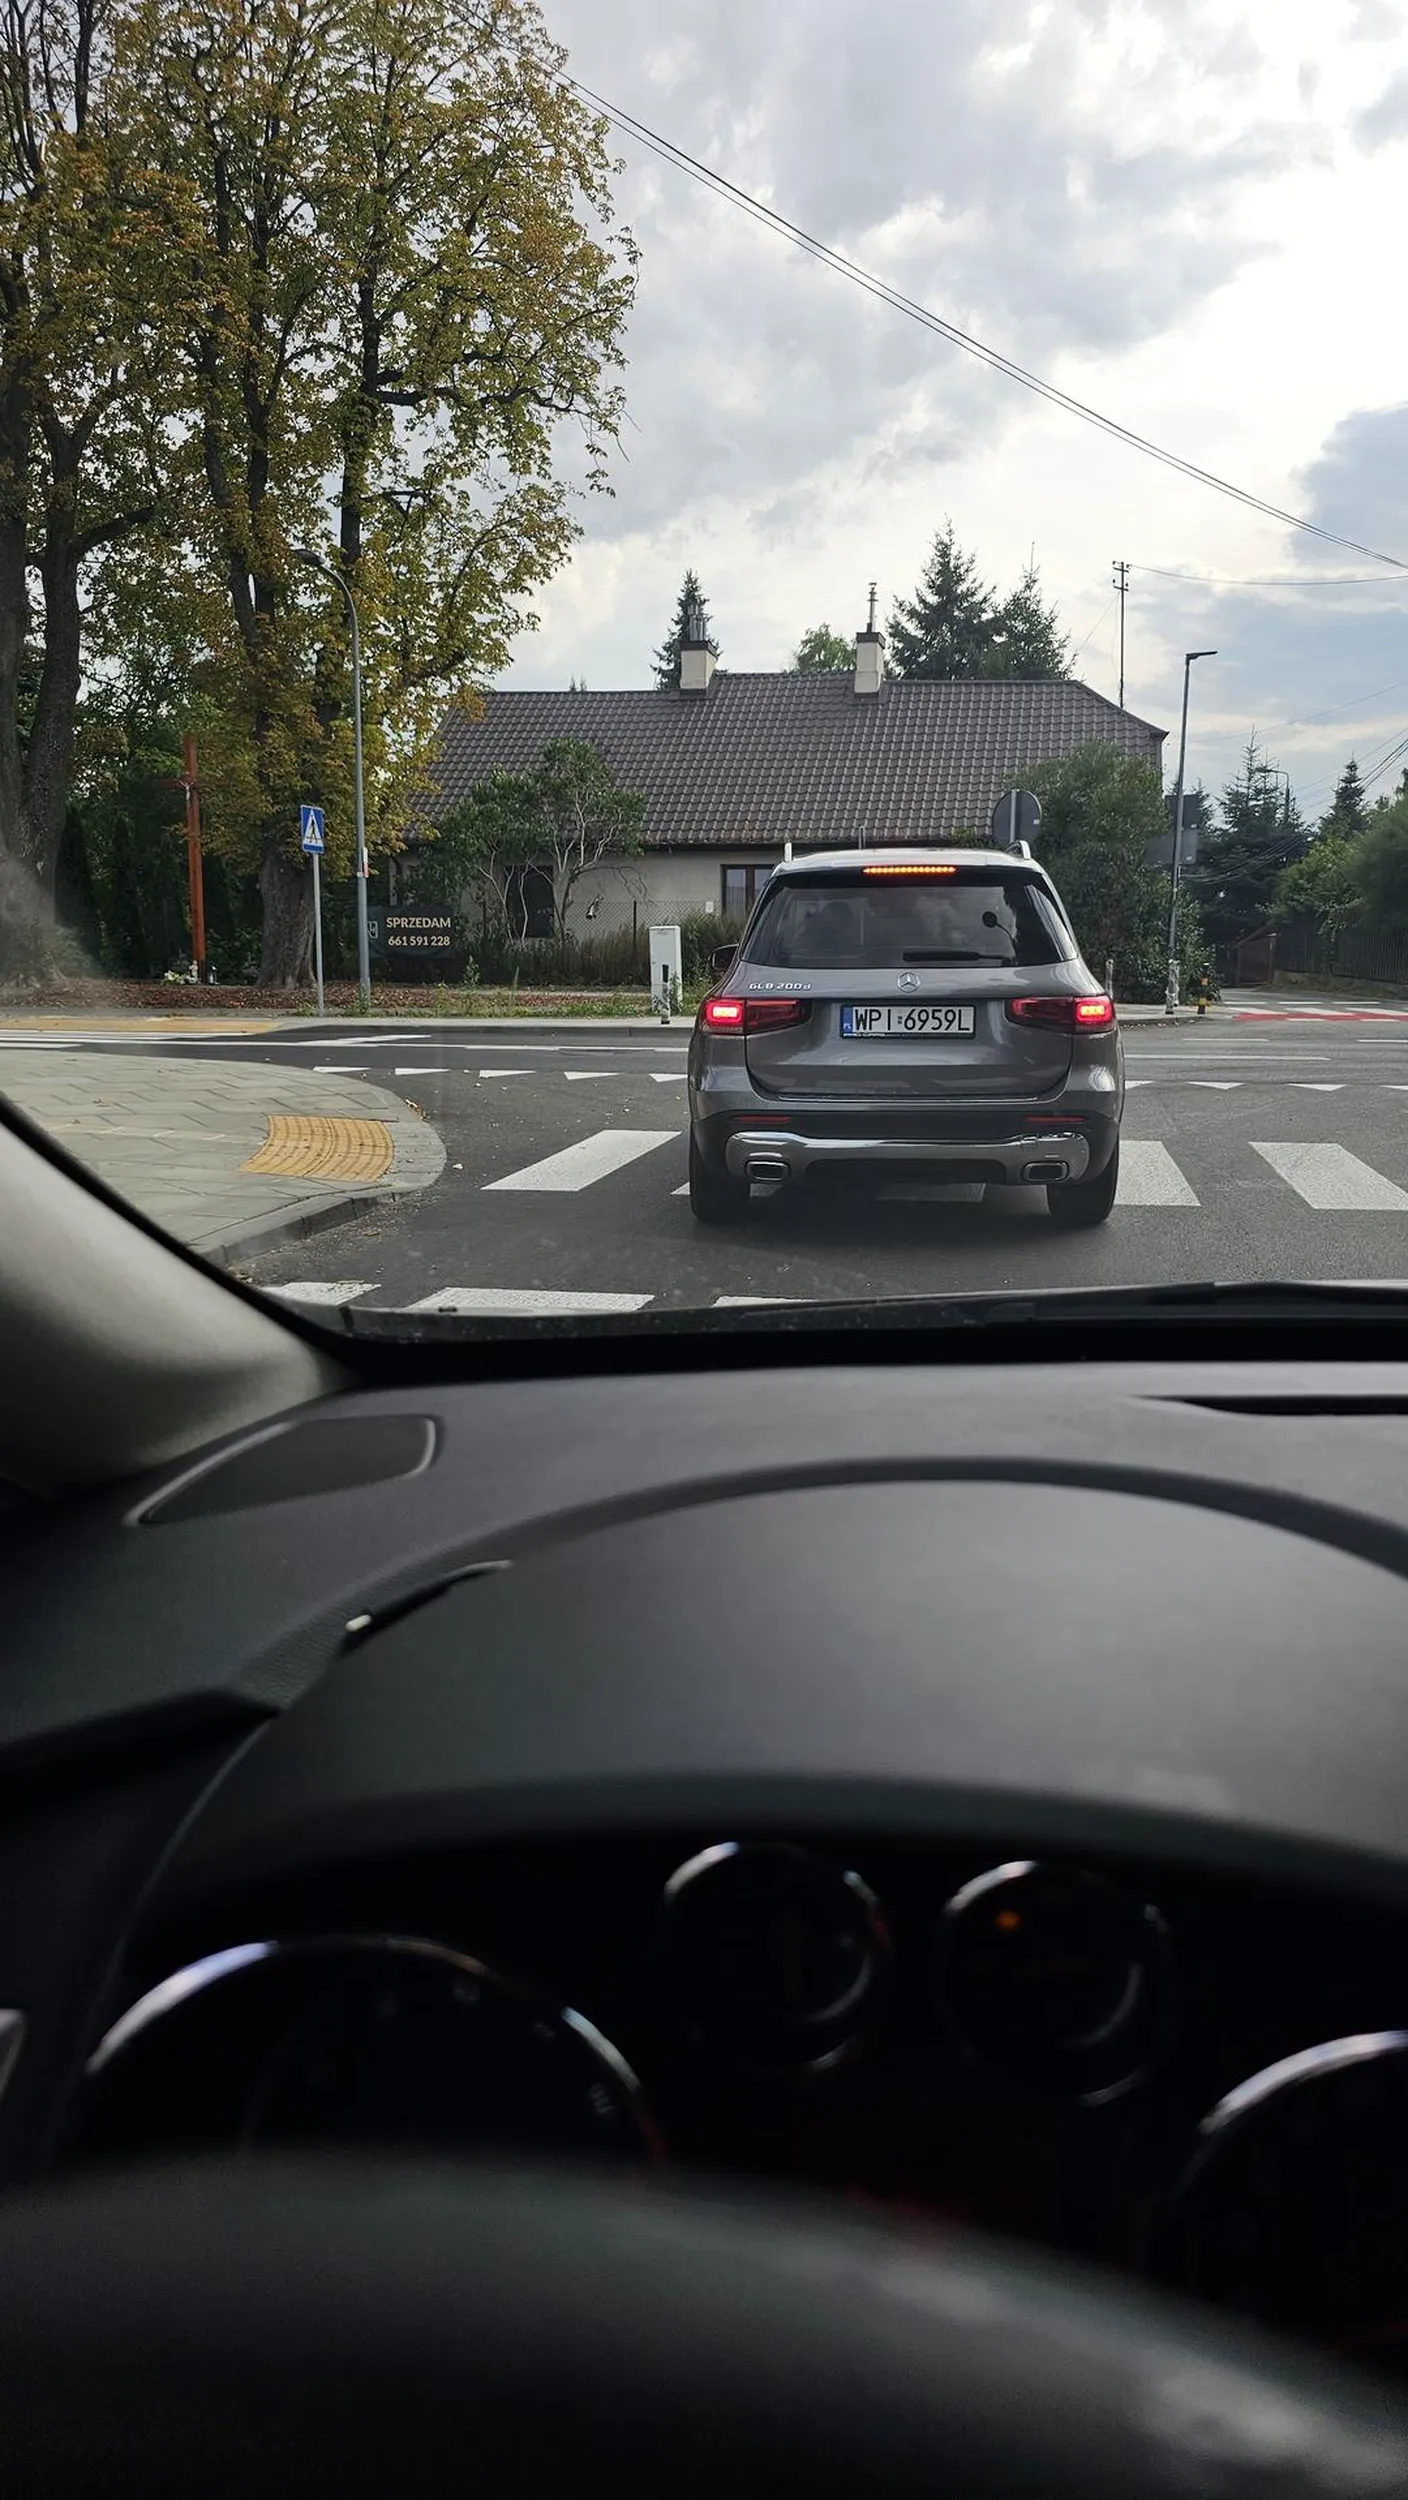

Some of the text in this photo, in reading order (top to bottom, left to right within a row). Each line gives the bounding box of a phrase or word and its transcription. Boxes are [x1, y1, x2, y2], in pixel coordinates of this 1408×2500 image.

[386, 917, 451, 929] SPRZEDAM
[387, 936, 451, 946] 661 591 228
[855, 1008, 970, 1031] WPI 6959L
